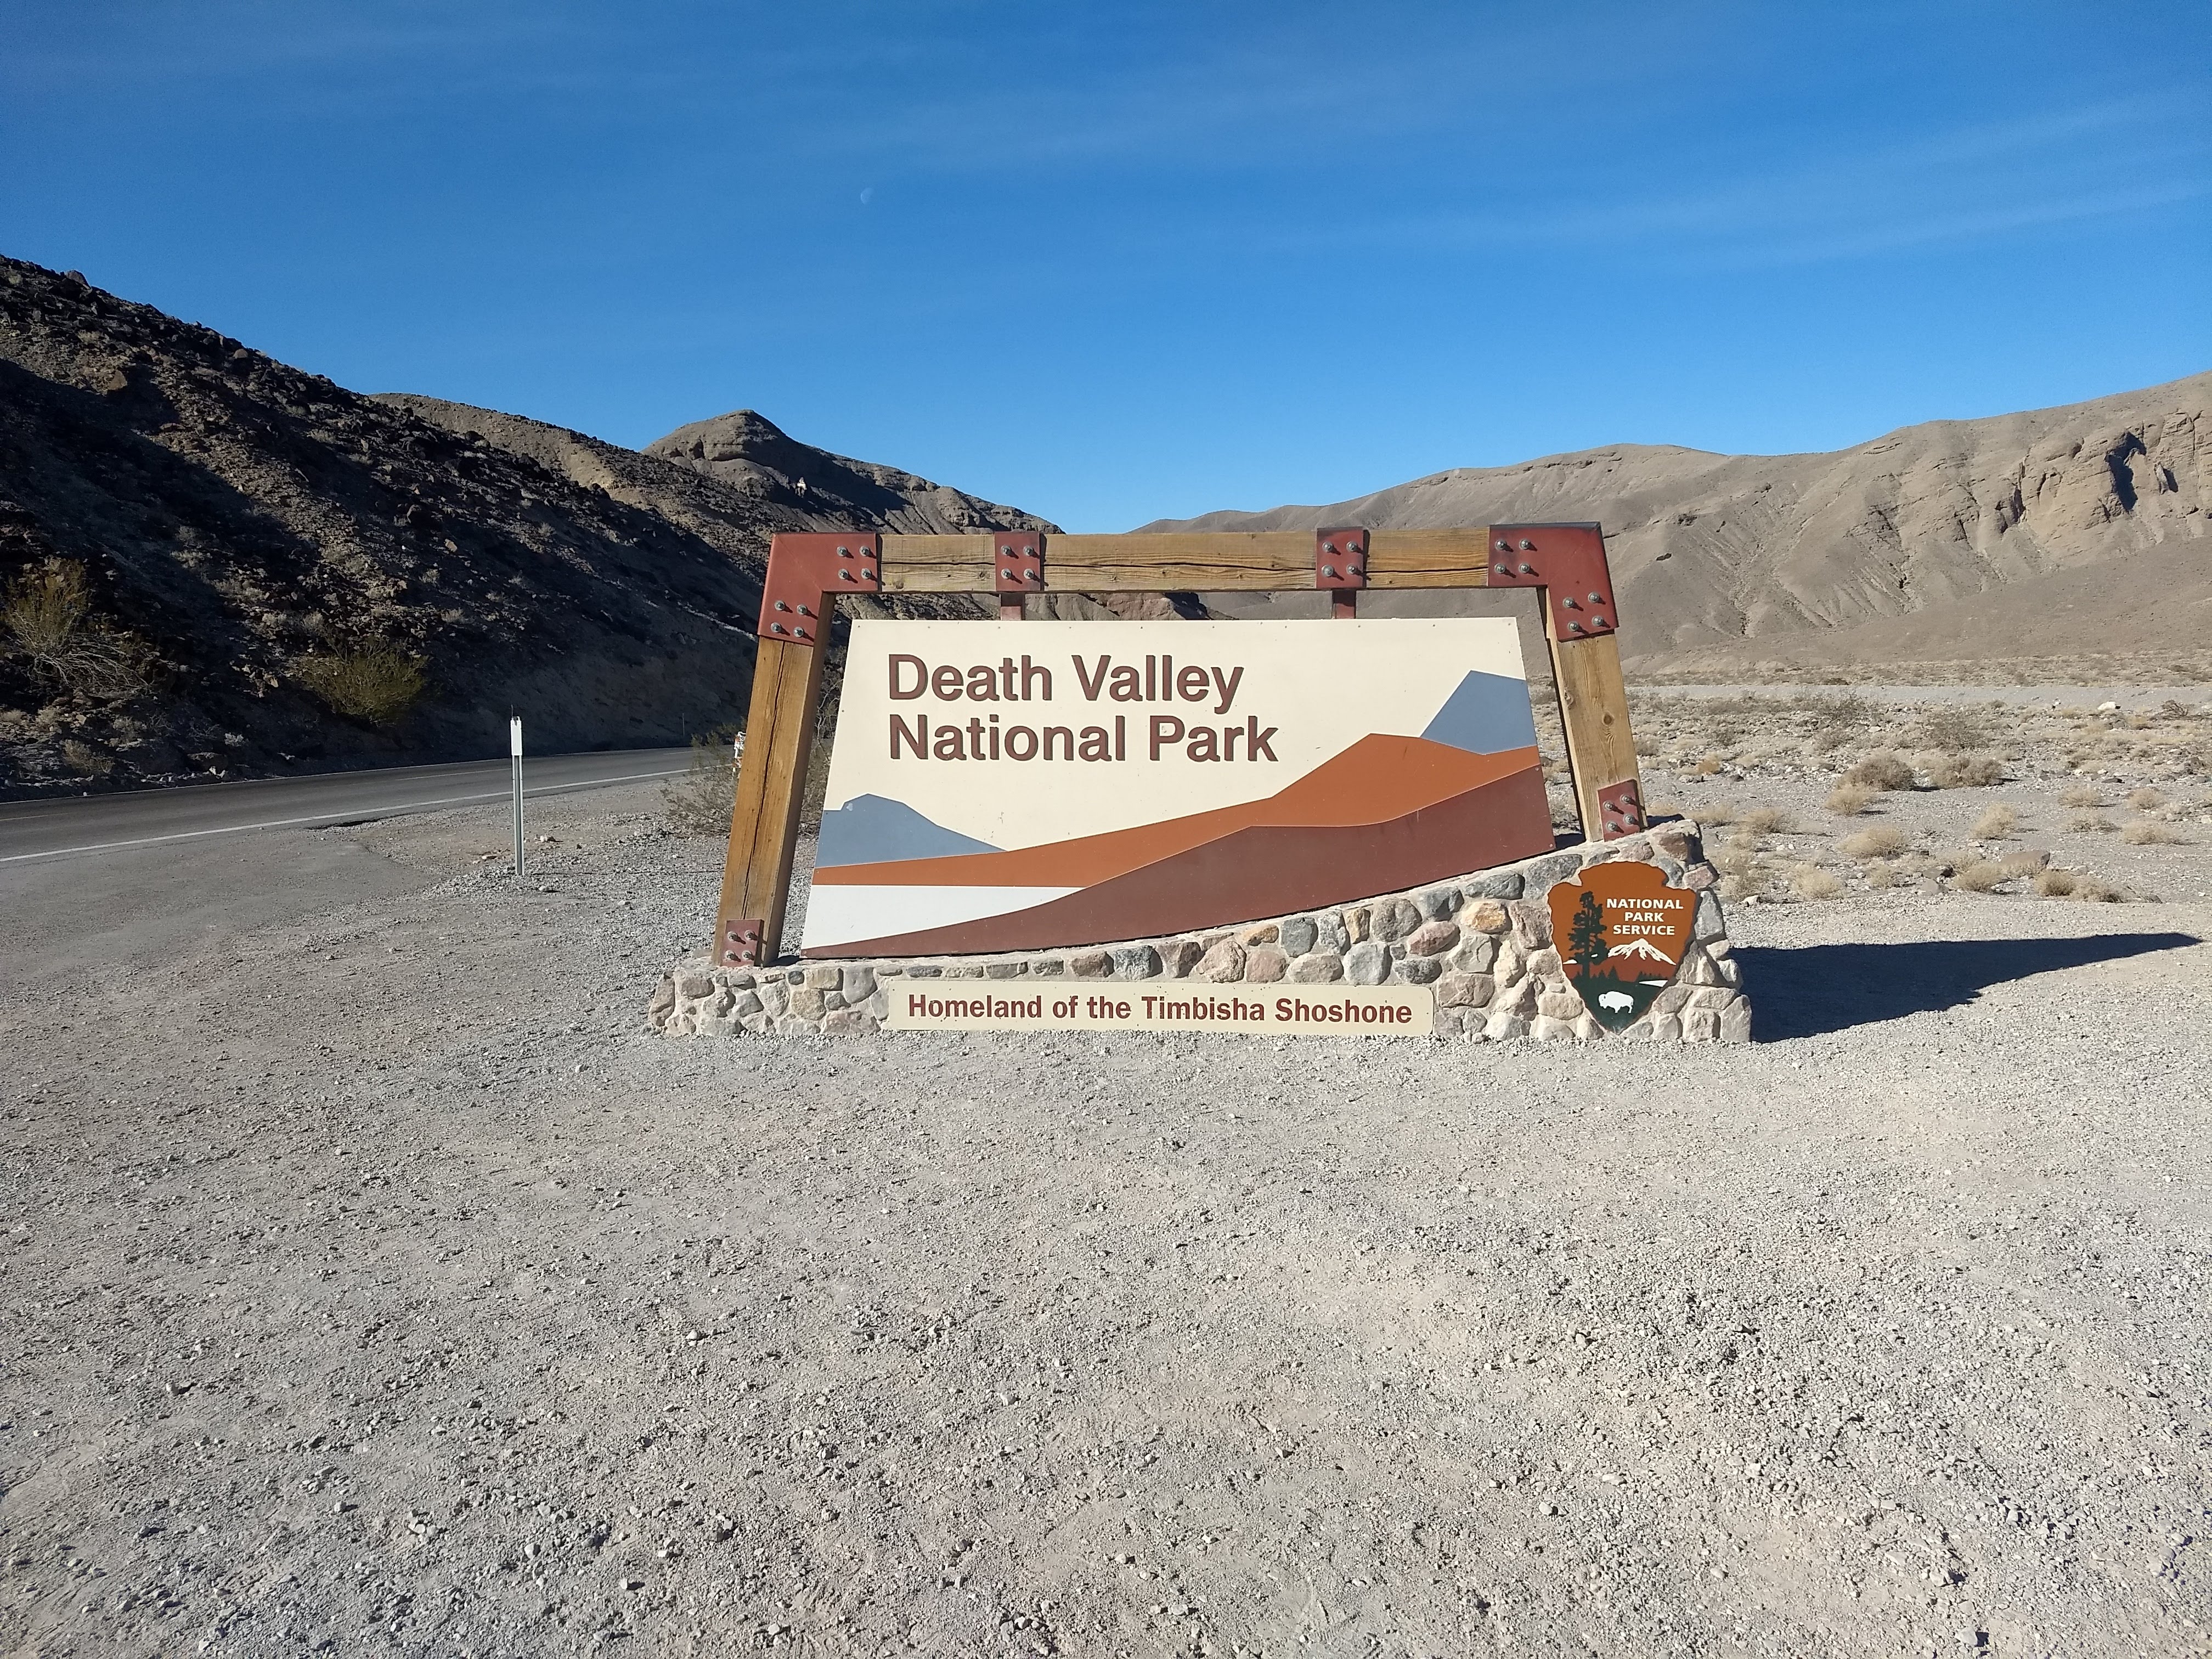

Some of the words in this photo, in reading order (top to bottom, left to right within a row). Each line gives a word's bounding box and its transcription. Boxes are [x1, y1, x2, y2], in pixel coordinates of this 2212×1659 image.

[889, 654, 1052, 702] Death
[1071, 654, 1244, 715] Valley
[889, 714, 1126, 761] National
[1149, 715, 1279, 762] Park
[1606, 898, 1684, 910] NATIONAL
[1624, 912, 1664, 922] PARK
[1613, 924, 1675, 935] SERVICE
[909, 995, 1042, 1018] Homeland
[1052, 995, 1077, 1018] of
[1086, 995, 1132, 1019] the
[1141, 996, 1265, 1020] Timbisha
[1274, 997, 1413, 1024] Shoshone
